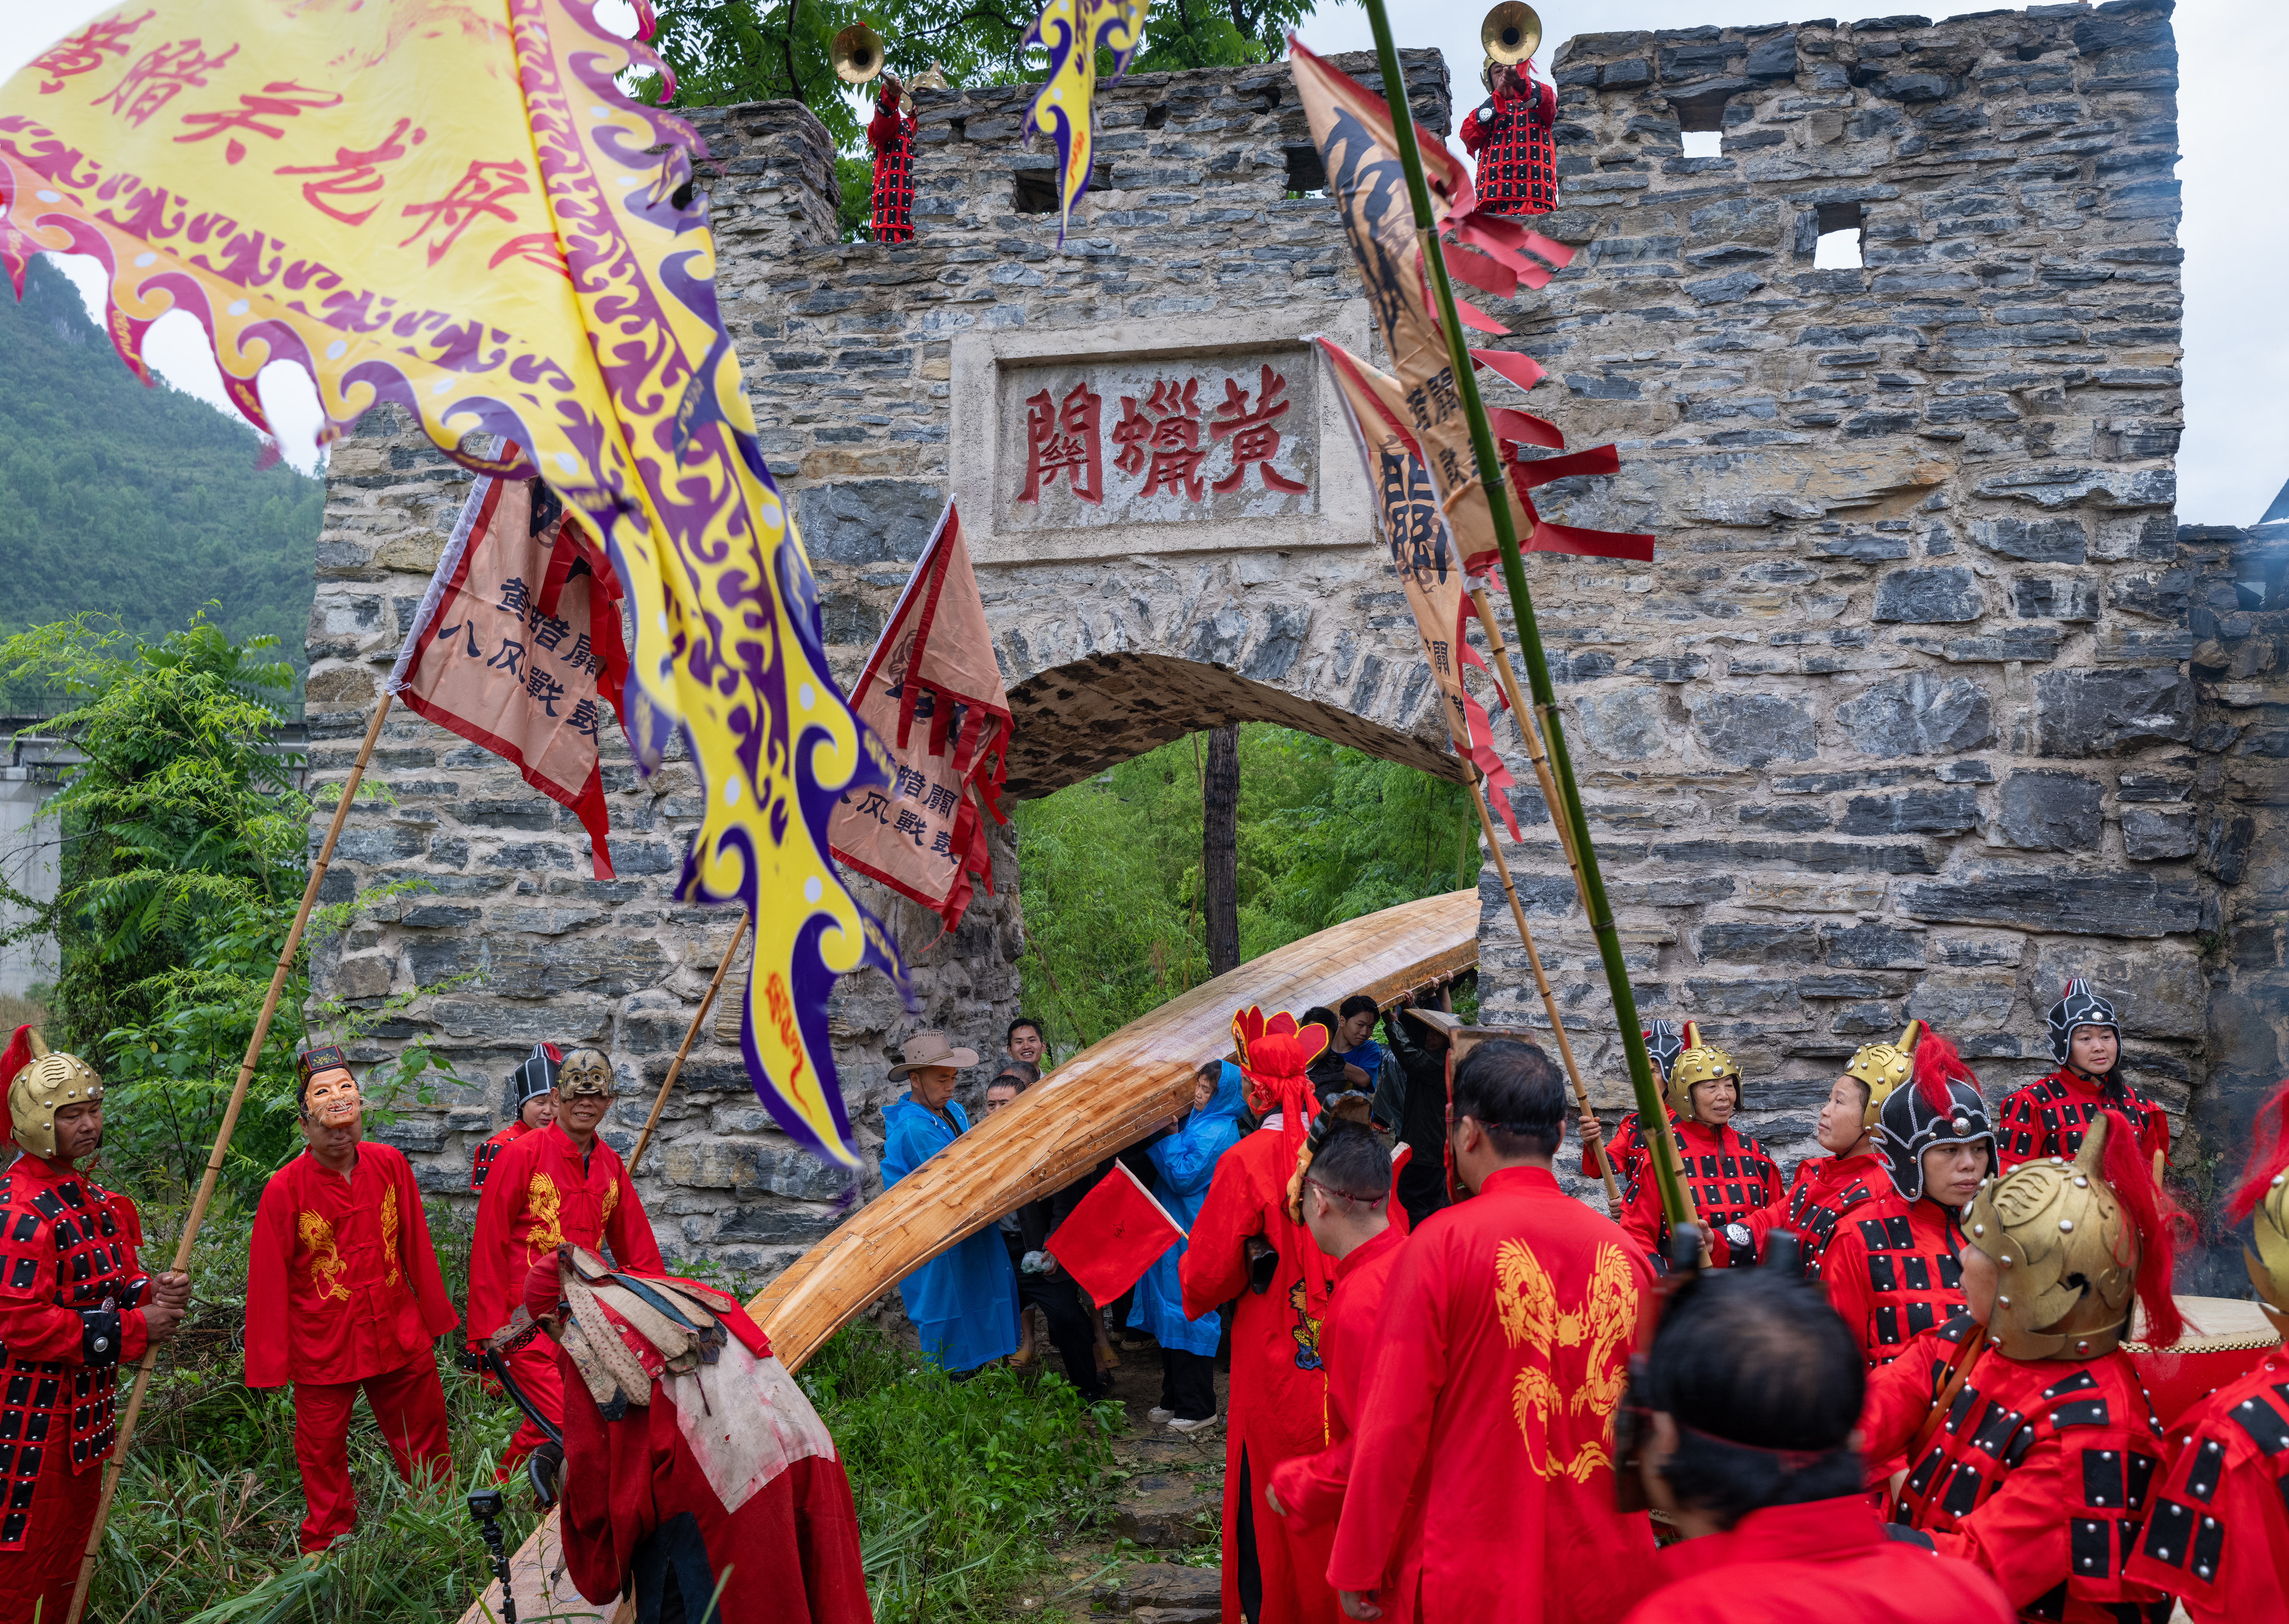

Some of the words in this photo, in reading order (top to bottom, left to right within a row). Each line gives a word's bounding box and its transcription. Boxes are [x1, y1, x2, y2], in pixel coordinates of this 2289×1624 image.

[27, 8, 572, 281] 黄腊关龙舟
[888, 753, 959, 819] 蜡關
[840, 791, 959, 865] 风戰鼓
